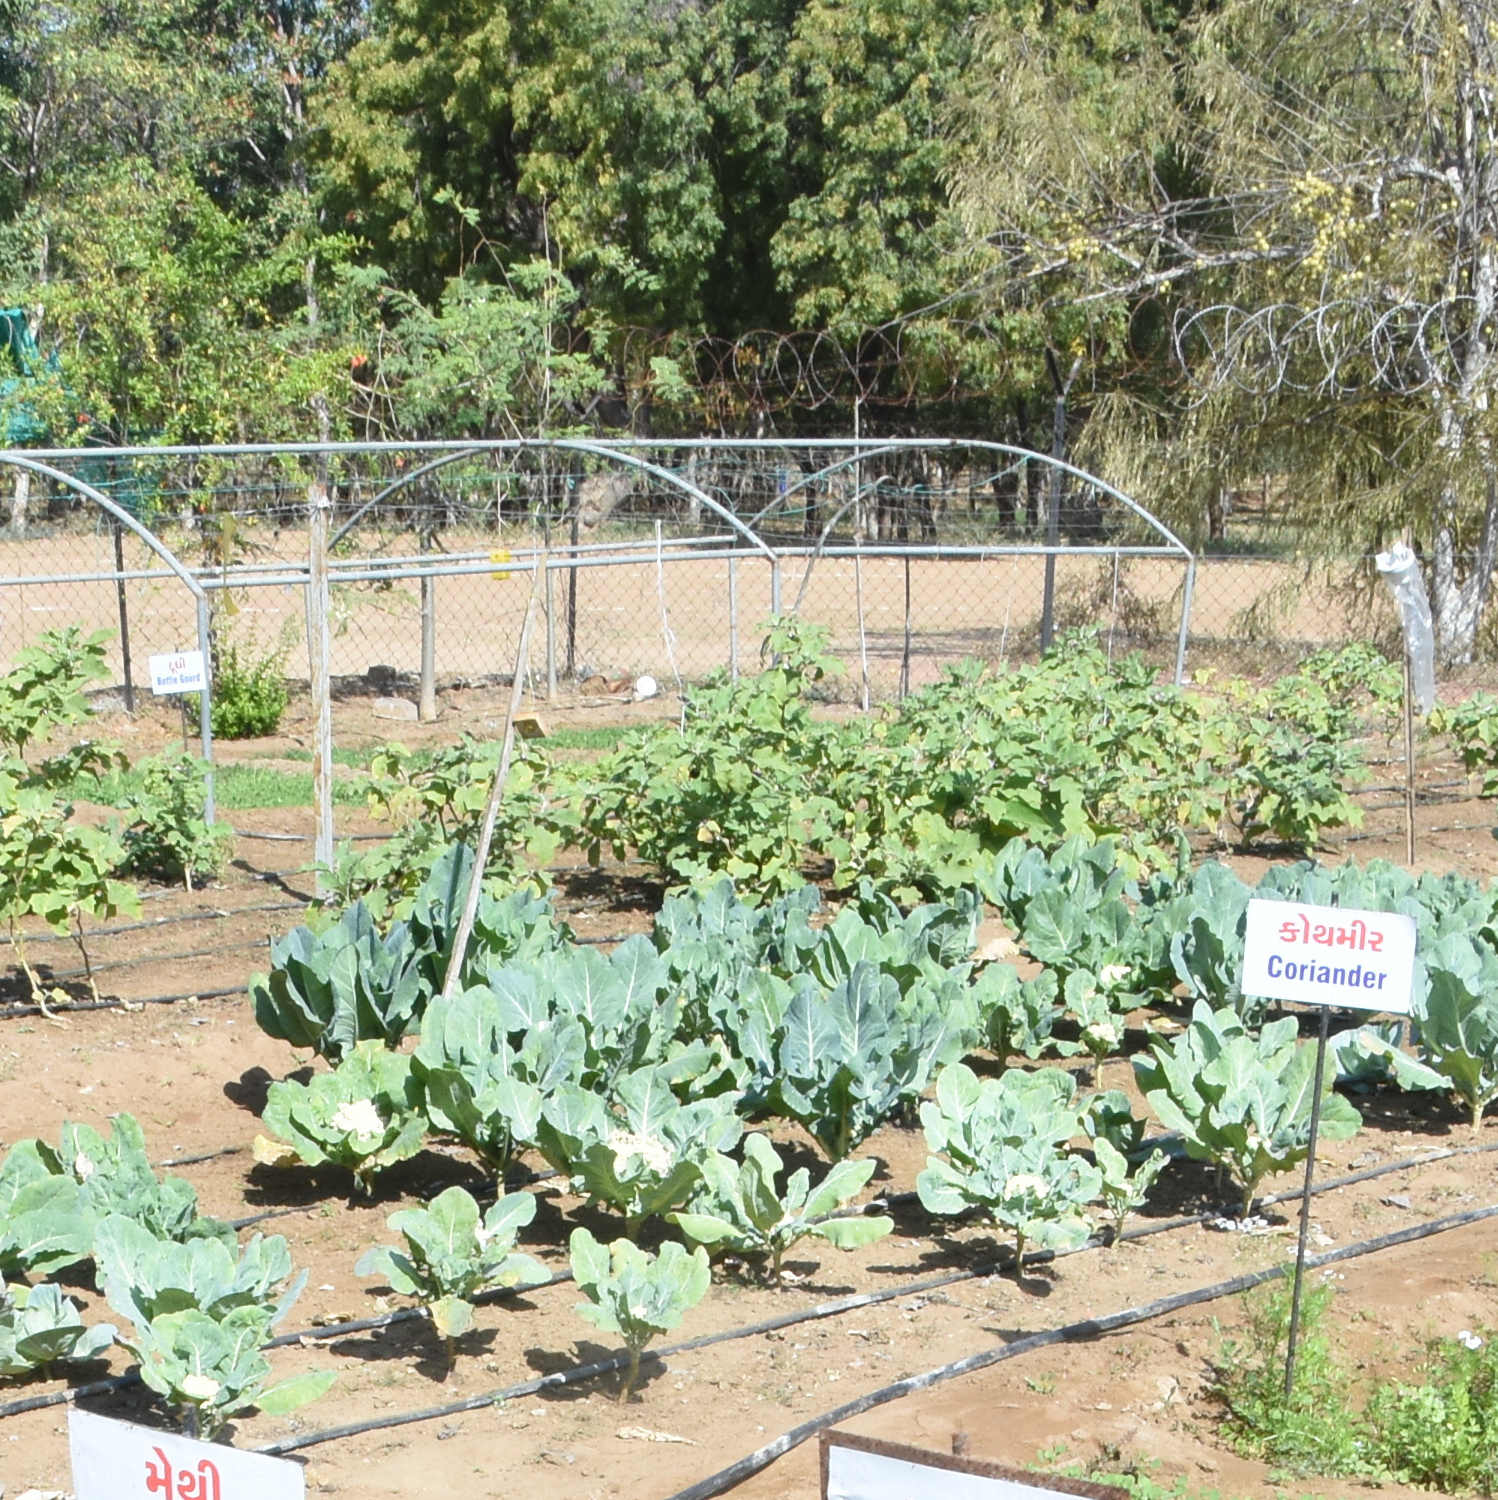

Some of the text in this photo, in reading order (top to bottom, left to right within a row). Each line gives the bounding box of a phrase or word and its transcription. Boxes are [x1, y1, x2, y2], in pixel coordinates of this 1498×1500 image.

[157, 673, 201, 686] Bottle Gourd
[1278, 912, 1384, 952] કોથમીર
[1267, 954, 1388, 990] Coriander
